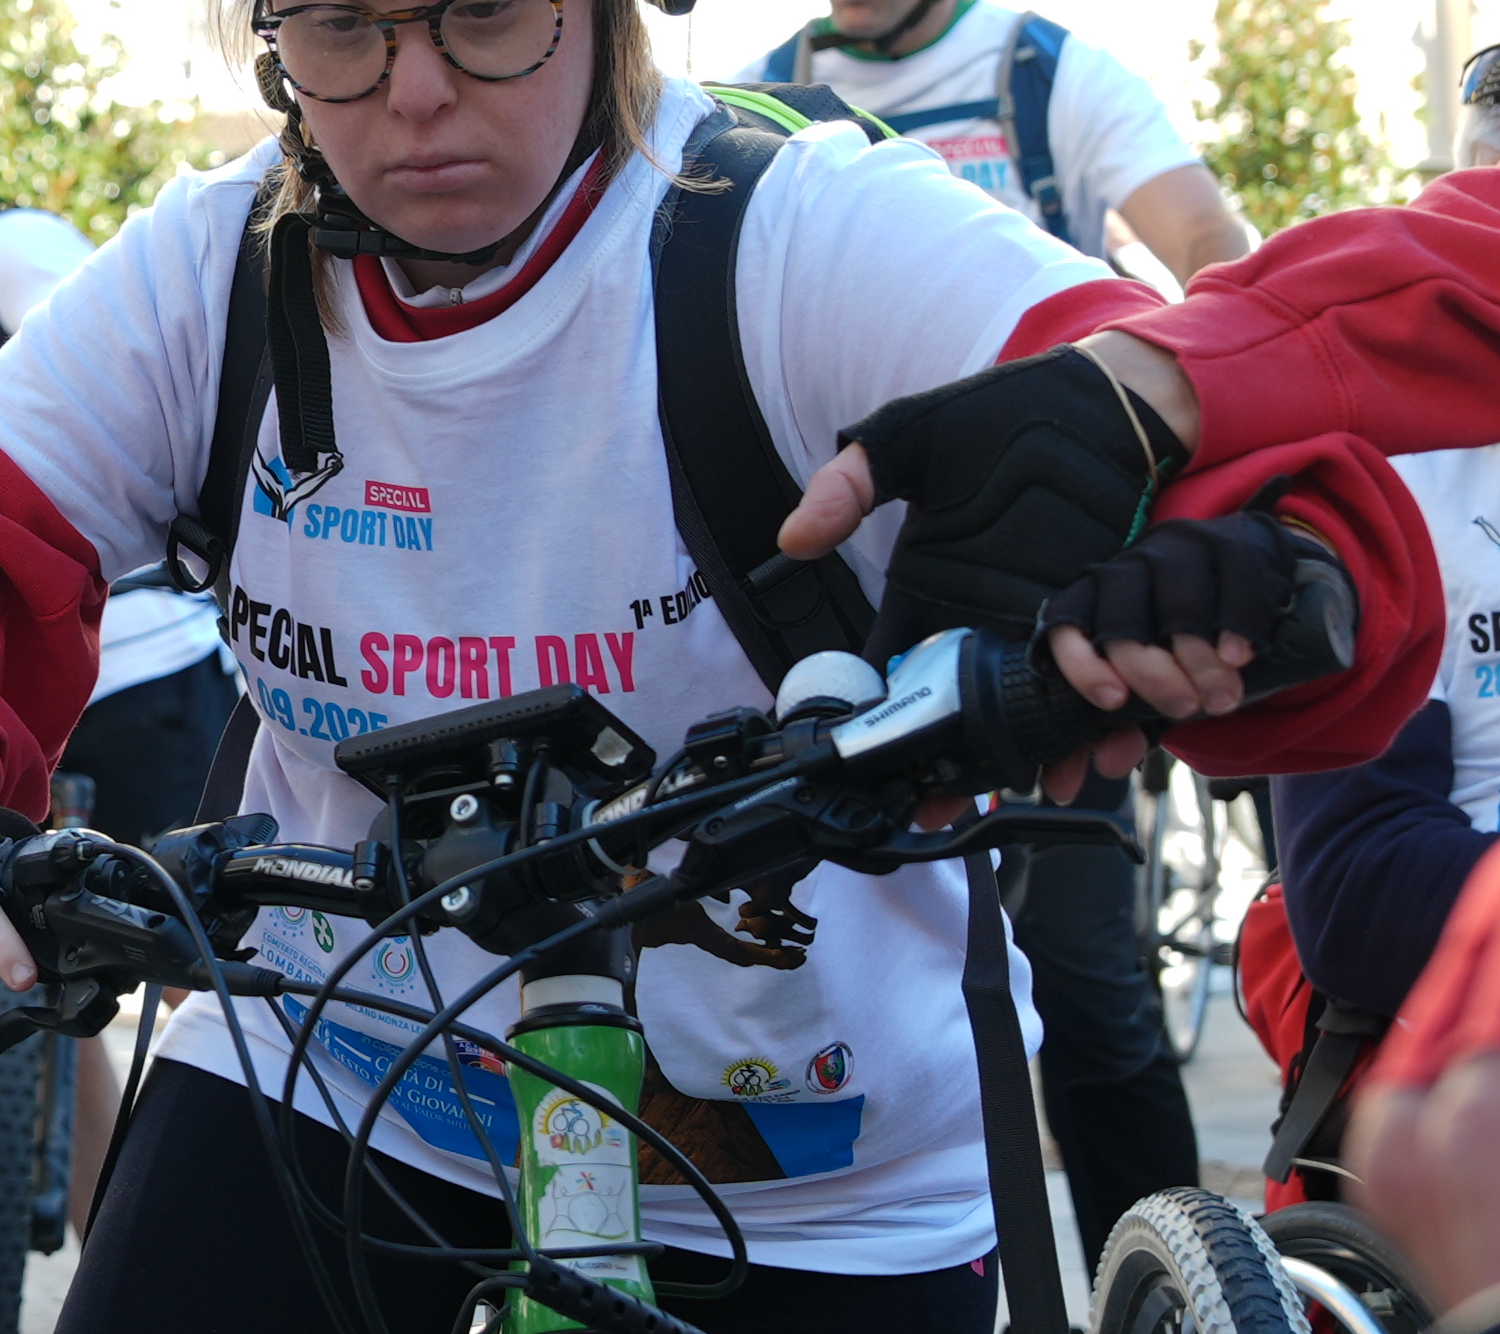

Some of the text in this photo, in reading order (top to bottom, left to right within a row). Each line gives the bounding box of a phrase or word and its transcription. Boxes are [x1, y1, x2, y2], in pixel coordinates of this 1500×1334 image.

[369, 485, 427, 510] SPECIAL
[303, 503, 434, 551] SPORT DAY
[230, 584, 635, 699] PECIAL SPORT DAY
[333, 1047, 370, 1080] SESTO
[375, 1055, 444, 1093] CITÀ DI
